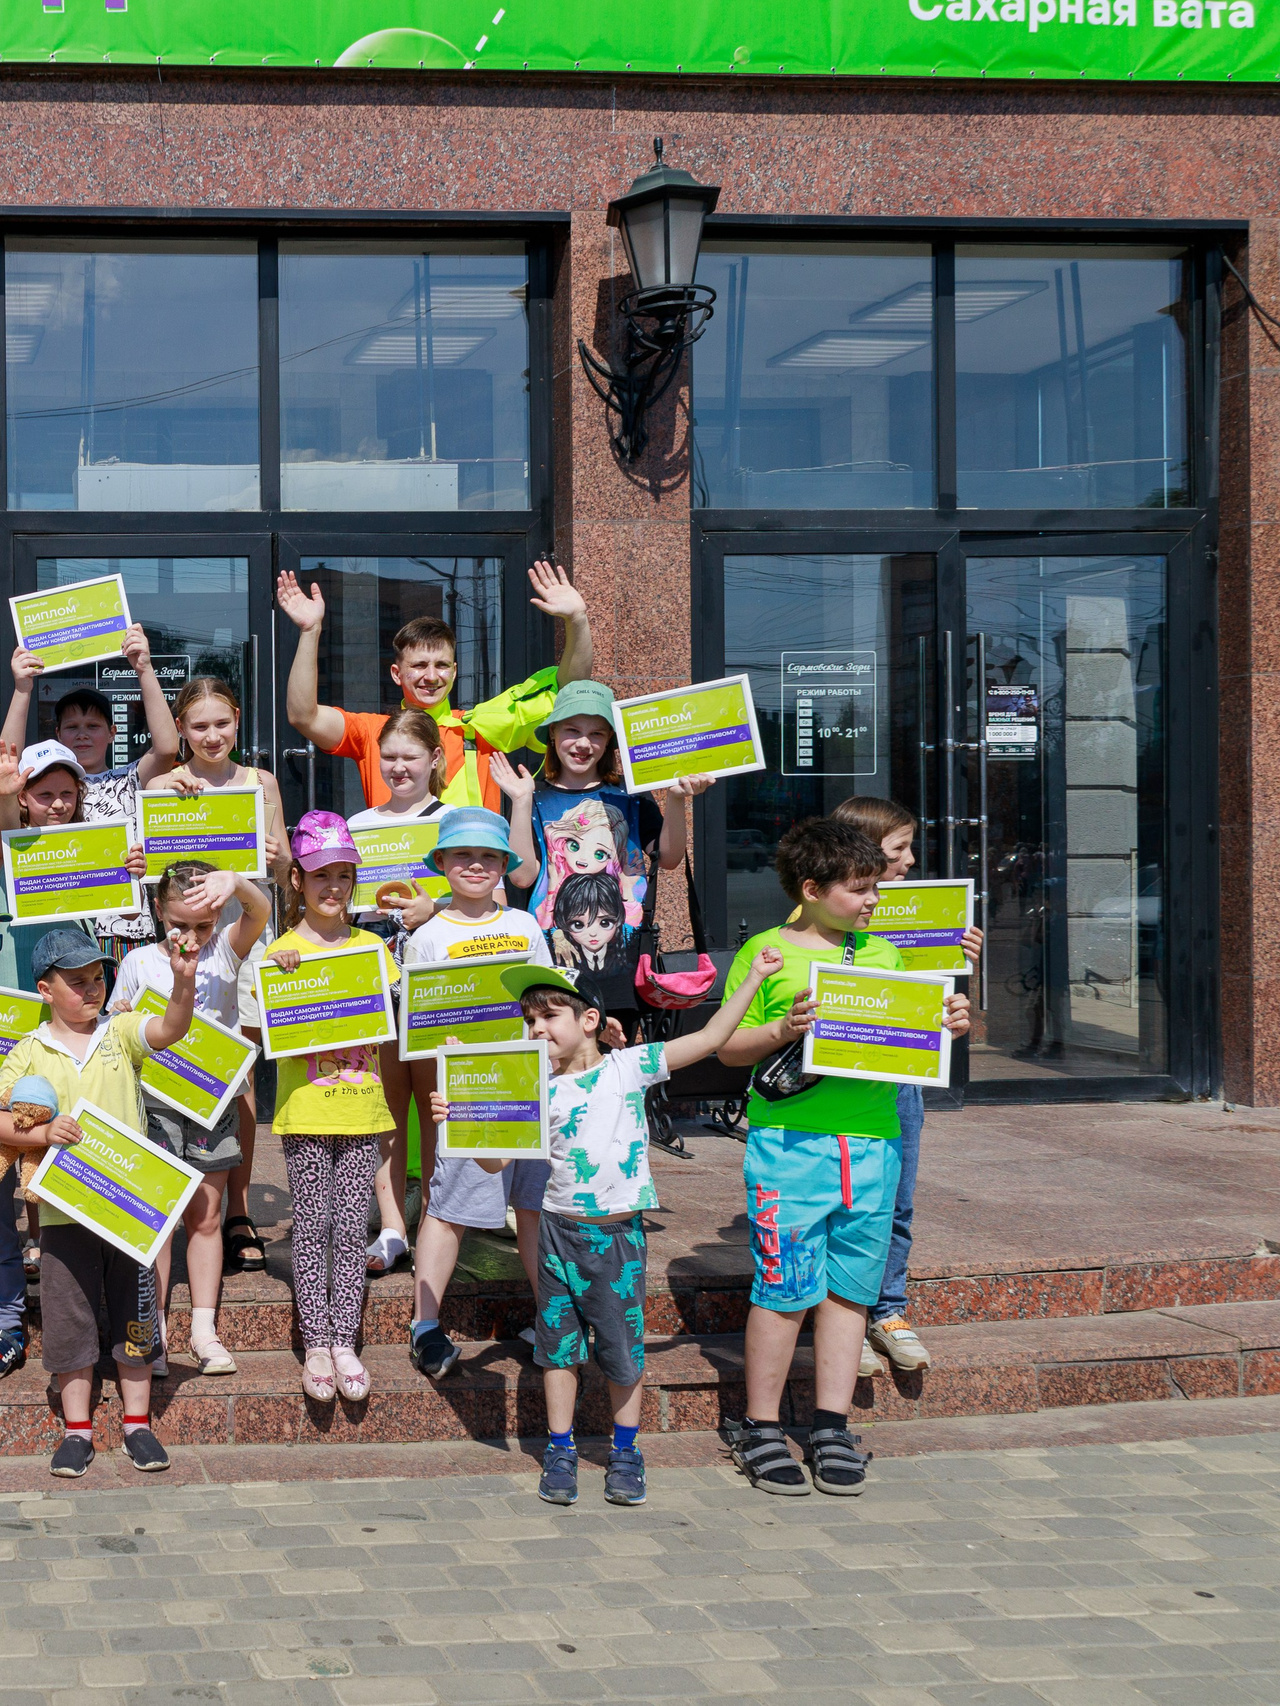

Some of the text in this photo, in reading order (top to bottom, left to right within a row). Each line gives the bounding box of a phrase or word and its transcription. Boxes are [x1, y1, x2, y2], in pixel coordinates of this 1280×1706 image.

[908, 0, 1254, 32] Сахарная вата
[23, 605, 77, 625] ДИПЛОМ
[27, 620, 114, 643] ВЫДАН САМОМУ ТАЛАНТЛИВОМУ
[28, 633, 82, 648] ЮНОМУ КОНДИТЕРУ
[787, 663, 871, 676] Сормовские Зори
[629, 711, 692, 734] ДИПЛОМ
[634, 729, 737, 754] ВЫДАН САМОМУ ТАЛАНТЛИВОМУ
[635, 743, 698, 760] ЮНОМУ КОНДИТЕРУ
[148, 812, 206, 825] ДИПЛОМ
[16, 848, 77, 865] ДИПЛОМ
[69, 870, 118, 880] ТАЛАНТЛИВОМУ
[44, 881, 80, 890] КОНДИТЕРУ
[473, 933, 511, 942] FUTURE
[462, 940, 523, 953] GENERATION
[267, 976, 330, 996] ДИПЛОМ
[413, 983, 475, 1000] ДИПЛОМ
[270, 998, 372, 1018] ВЫДАН САМОМУ ТАЛАНТЛИВОМУ
[464, 1005, 512, 1015] ТАЛАНТЛИВОМУ
[821, 992, 888, 1011] ДИПЛОМ
[271, 1011, 334, 1025] ЮНОМУ КОНДИТЕРУ
[438, 1015, 474, 1024] КОНДИТЕРУ
[820, 1030, 886, 1043] ЮНОМУ КОНДИТЕРУ
[846, 1026, 874, 1034] САМОМУ
[876, 1029, 928, 1040] ТАЛАНТЛИВОМУ
[324, 1089, 338, 1098] of
[76, 1130, 135, 1174] ДИПЛОМ
[58, 1159, 117, 1201] ЮНОМУ КОНДИТЕРУ
[62, 1154, 156, 1218] ВЫДАН САМОМУ ТАЛАНТЛИВОМУ
[756, 1184, 783, 1284] HEAT
